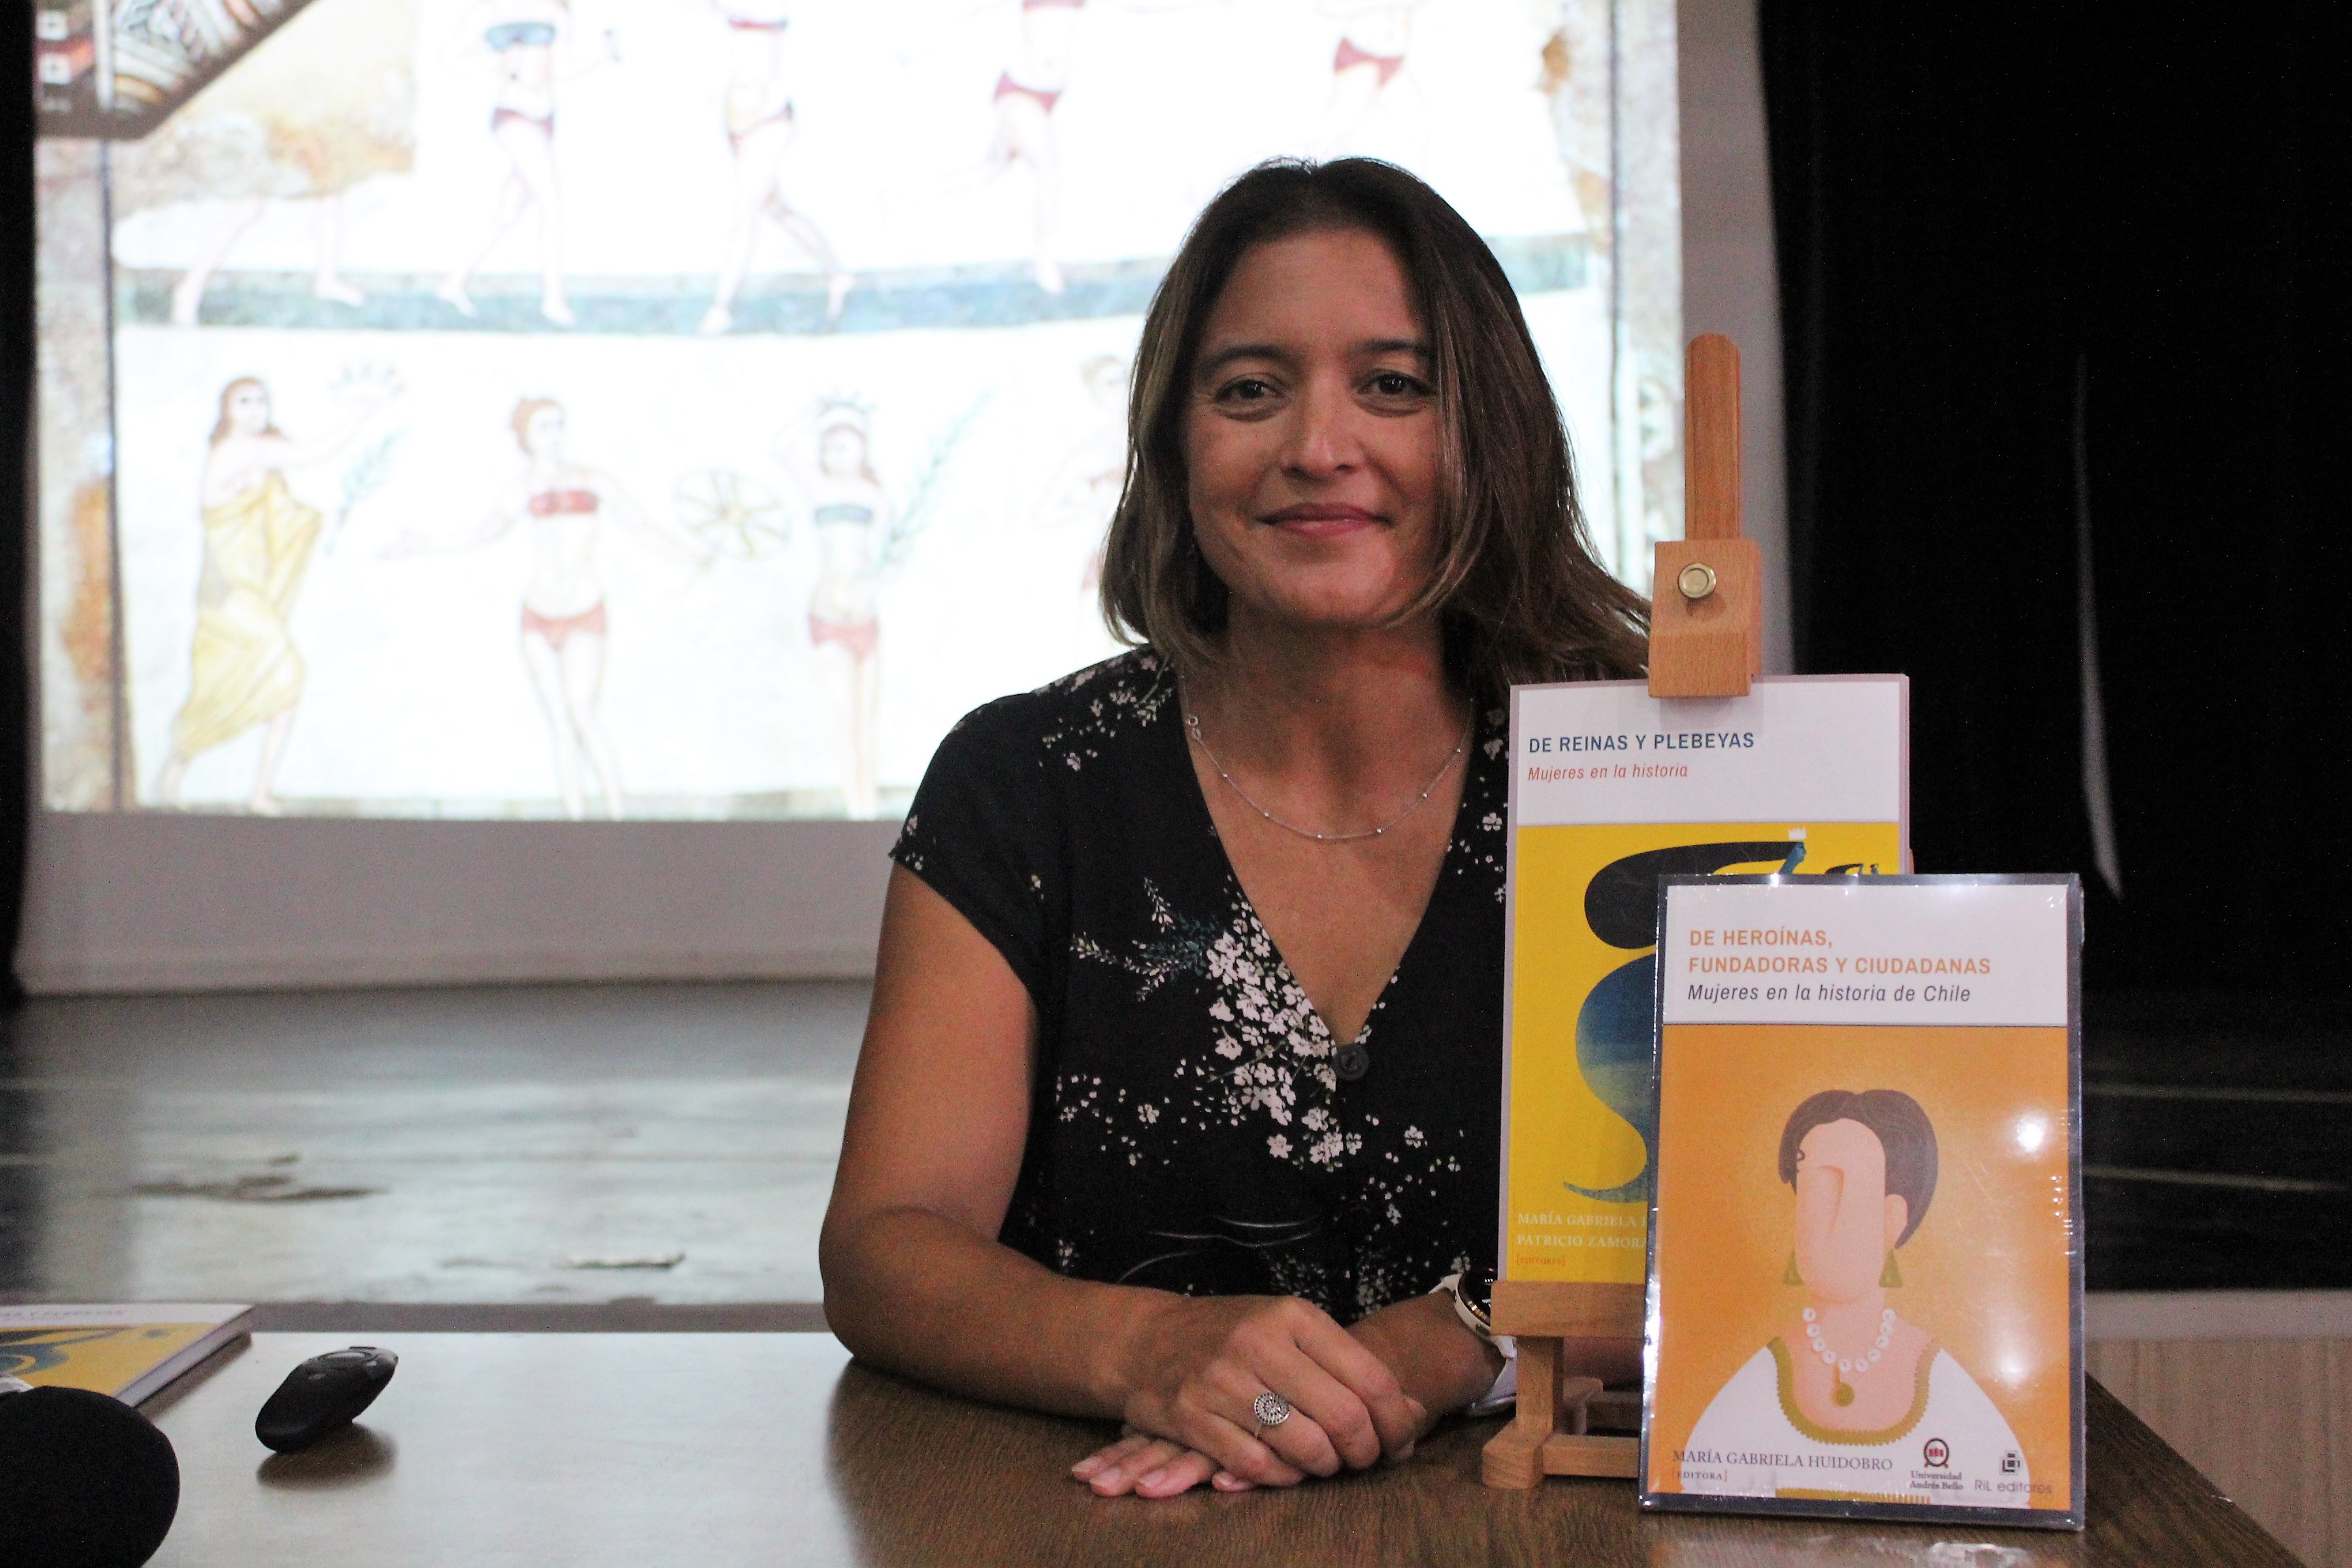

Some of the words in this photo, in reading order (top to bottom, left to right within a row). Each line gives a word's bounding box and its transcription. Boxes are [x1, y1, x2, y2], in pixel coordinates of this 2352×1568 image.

[1529, 737, 1552, 753] DE
[1559, 735, 1628, 751] REINAS
[1635, 734, 1646, 749] Y
[1654, 732, 1754, 749] PLEBEYAS
[1528, 765, 1584, 783] Mujeres
[1590, 767, 1607, 779] en
[1614, 764, 1627, 778] la
[1633, 762, 1688, 777] historia
[1690, 930, 1714, 946] DE
[1723, 926, 1832, 949] HEROÍNAS,
[1689, 957, 1827, 973] FUNDADORAS
[1836, 958, 1847, 973] Y
[1855, 958, 1991, 974] CIUDADANAS
[1688, 984, 1759, 1004] Mujeres
[1767, 987, 1788, 1000] en
[1795, 984, 1810, 1000] la
[1818, 984, 1886, 1001] historia
[1894, 985, 1915, 1002] de
[1924, 985, 1970, 1002] Chile
[1518, 1210, 1563, 1225] MARÍA
[1567, 1214, 1637, 1226] GABRIELA
[1516, 1235, 1582, 1247] PATRICIO
[1672, 1449, 1722, 1463] MARÍA
[1727, 1452, 1803, 1467] GABRIELA
[1808, 1455, 1893, 1471] HUIDOBRO
[1911, 1470, 1962, 1480] Universidad
[1910, 1480, 1940, 1490] Andrés
[1941, 1482, 1963, 1491] Bello
[1997, 1481, 2053, 1494] editores
